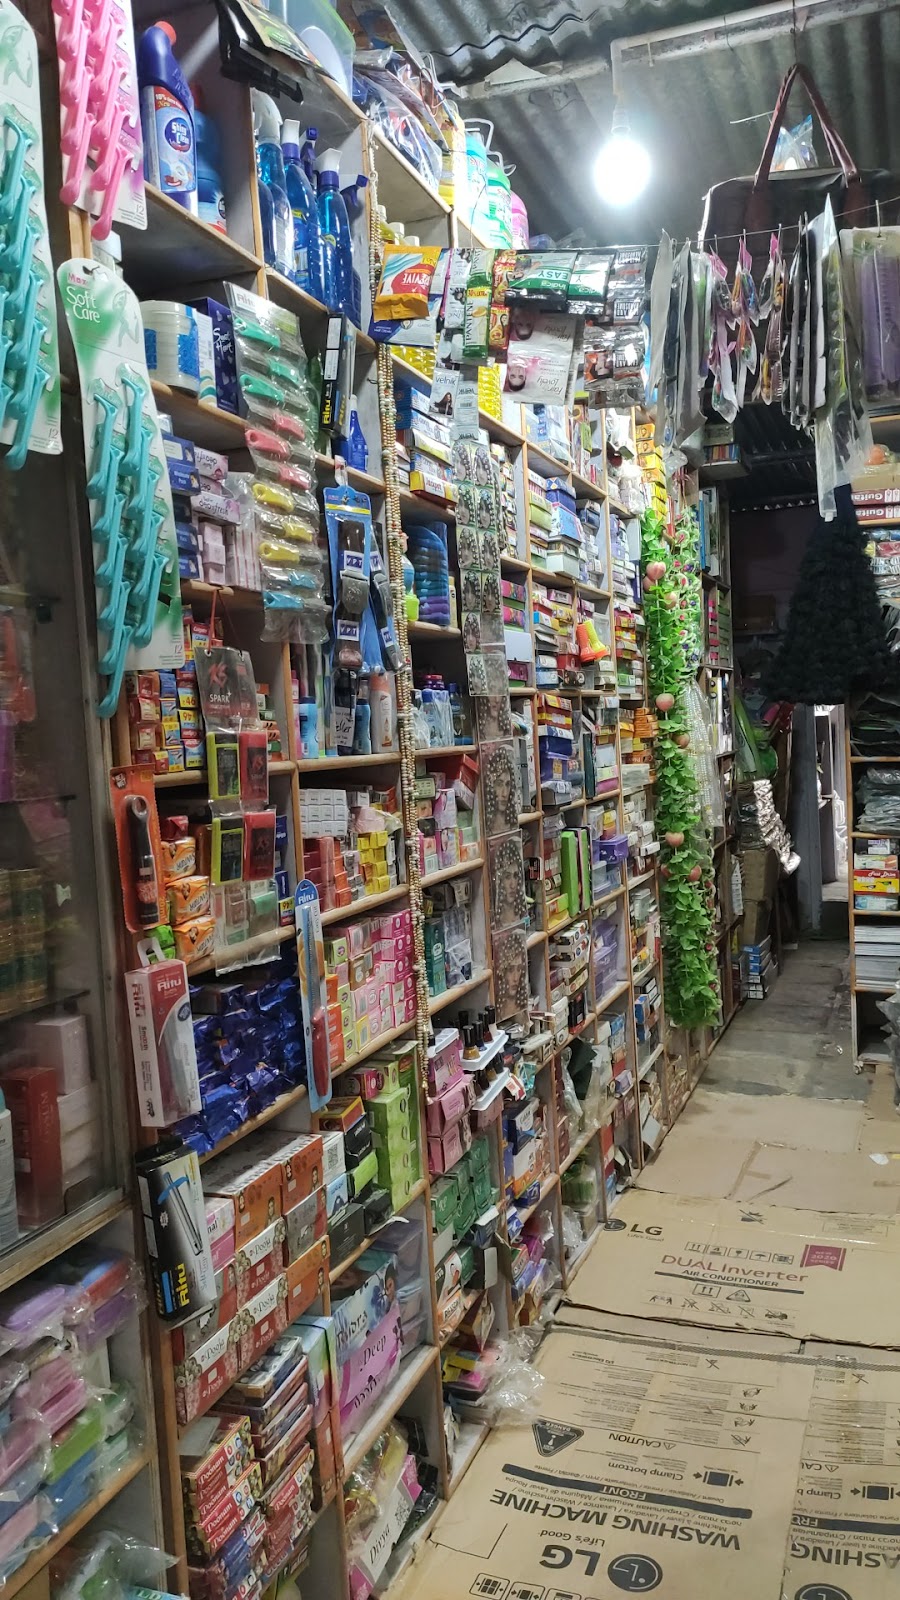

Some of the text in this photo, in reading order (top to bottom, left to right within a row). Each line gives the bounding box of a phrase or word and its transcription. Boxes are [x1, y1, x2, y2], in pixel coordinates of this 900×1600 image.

[537, 270, 569, 280] EASY
[541, 281, 567, 290] Indica
[66, 286, 97, 309] Soft
[73, 304, 101, 323] Care
[435, 376, 456, 386] velnik
[536, 375, 559, 387] Lovely
[209, 693, 230, 703] SPARK
[298, 890, 314, 904] Ritu
[157, 977, 182, 992] Ritu
[630, 1223, 663, 1236] LG
[661, 1254, 809, 1282] DUAL Inverter
[176, 1263, 190, 1306] Ritu
[681, 1269, 779, 1287] AIR CONDITIONER
[204, 1338, 225, 1360] Pooja
[363, 1335, 387, 1366] Deep
[609, 1433, 661, 1448] CAUTION
[198, 1455, 225, 1484] Poonam
[608, 1462, 648, 1475] bottom
[649, 1469, 684, 1481] Clamp
[505, 1476, 528, 1487] Roupa
[202, 1486, 227, 1515] Poonam
[274, 1484, 296, 1511] Poonam
[517, 1488, 576, 1506] Waschmaschine
[561, 1489, 593, 1501] Máquina
[601, 1485, 647, 1501] FRONT
[806, 1489, 841, 1500] Clamp
[583, 1501, 617, 1512] Lavatrice
[624, 1508, 659, 1520] Lavadora
[636, 1503, 690, 1518] Стиральная
[207, 1502, 233, 1533] Poonam
[490, 1489, 740, 1550] WASHING MACHINE
[666, 1516, 685, 1525] laver
[212, 1517, 238, 1549] Poonam
[693, 1520, 728, 1532] Machine
[369, 1523, 390, 1564] Divya
[540, 1530, 606, 1548] Life's Good
[801, 1536, 835, 1547] Lavadora
[539, 1544, 601, 1577] LG
